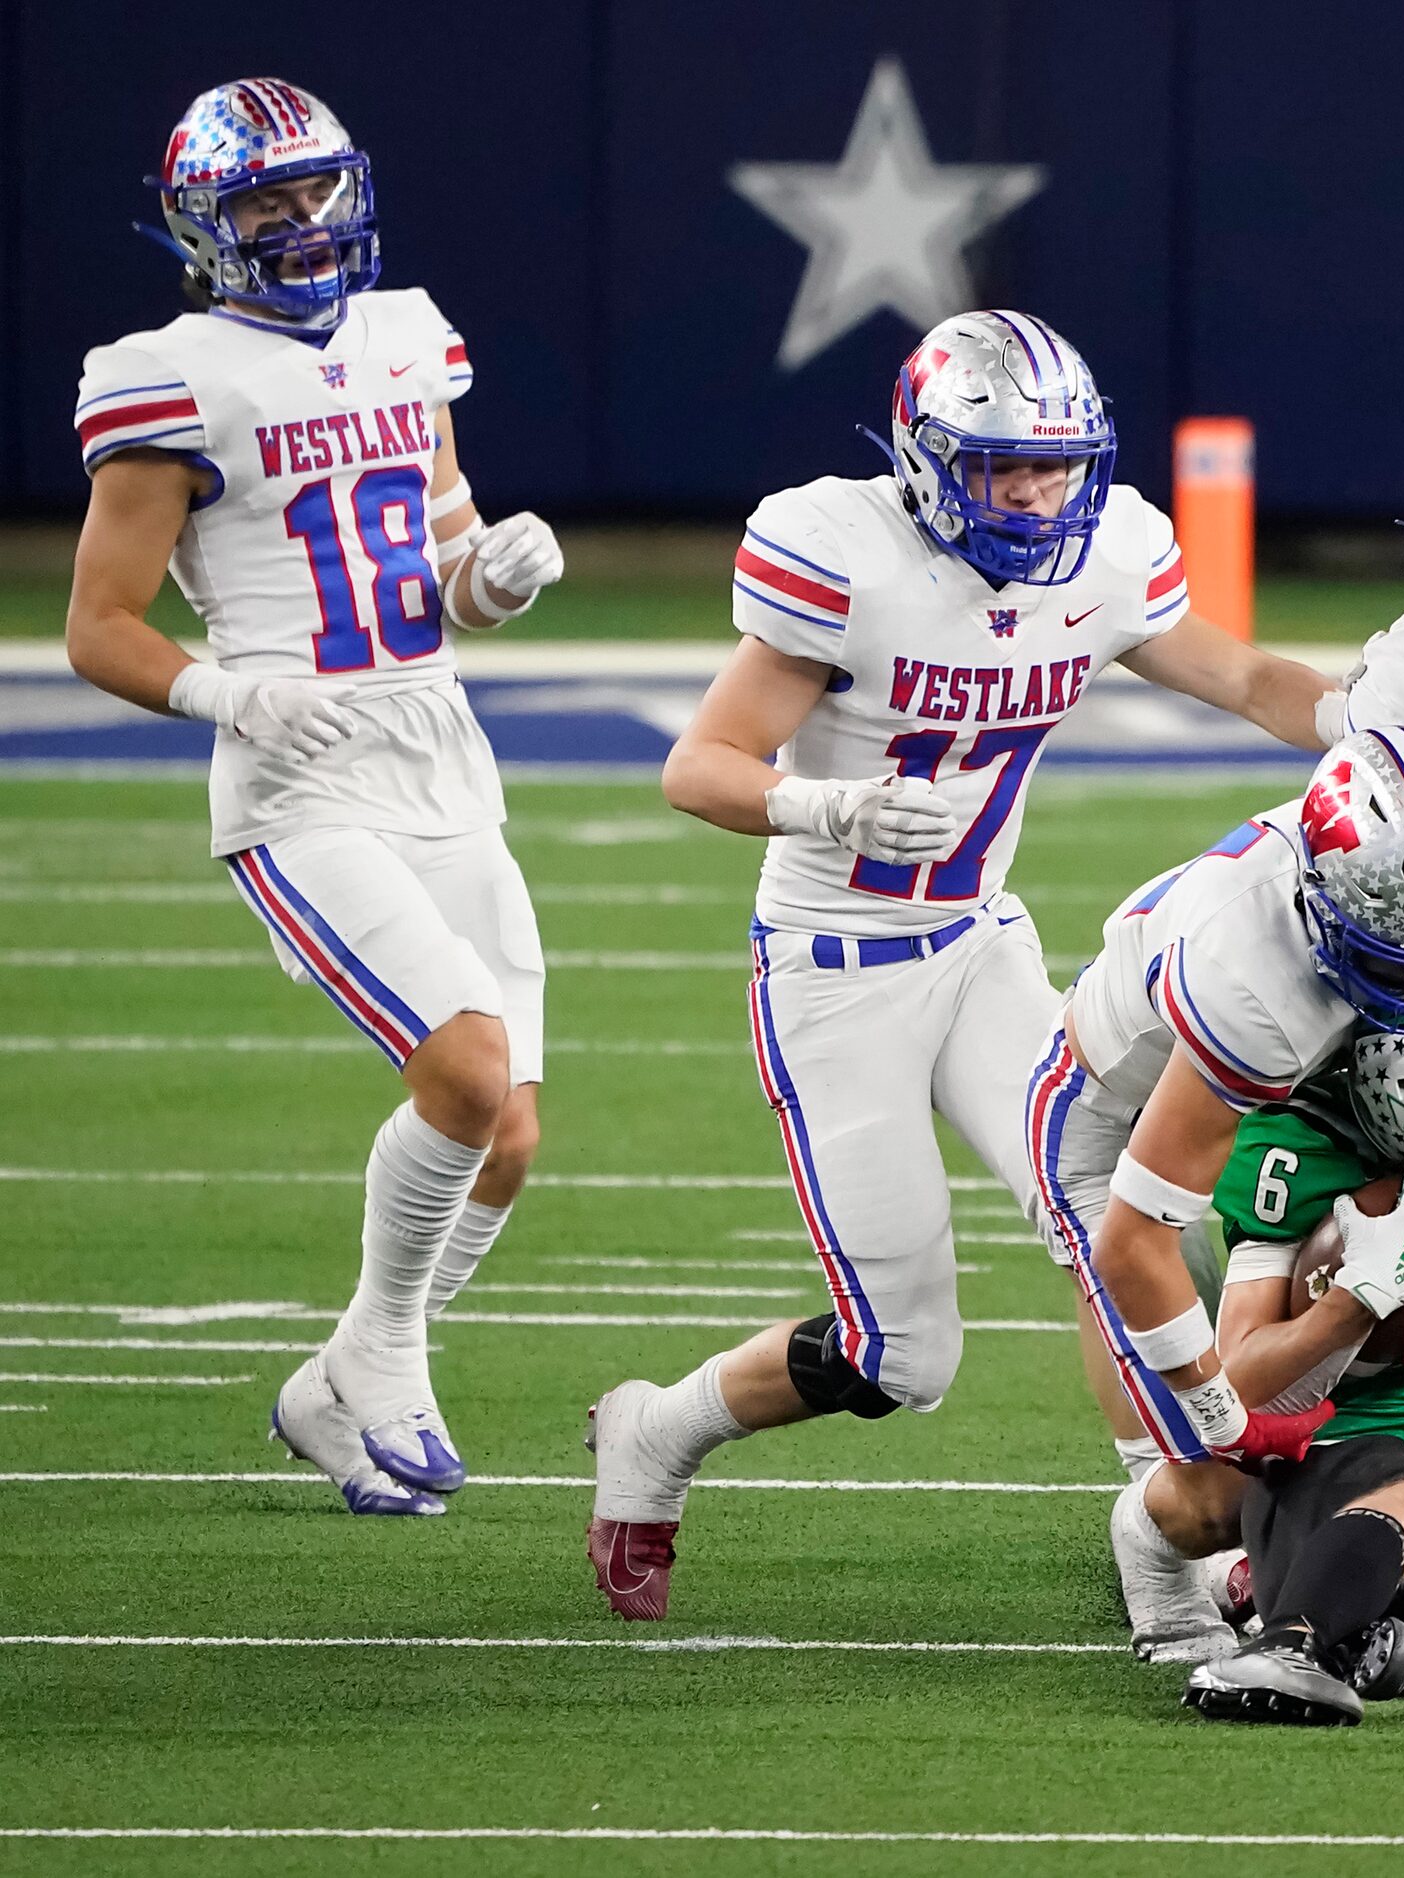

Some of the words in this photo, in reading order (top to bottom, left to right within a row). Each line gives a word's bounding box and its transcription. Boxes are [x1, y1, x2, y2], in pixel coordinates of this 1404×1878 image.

[271, 138, 320, 157] Riddell
[256, 401, 430, 478] WESTLAKE
[1032, 424, 1080, 436] Riddell
[283, 464, 443, 674] 18
[889, 654, 1091, 722] WESTLAKE
[849, 722, 1058, 901] 17
[1254, 1147, 1299, 1224] 6
